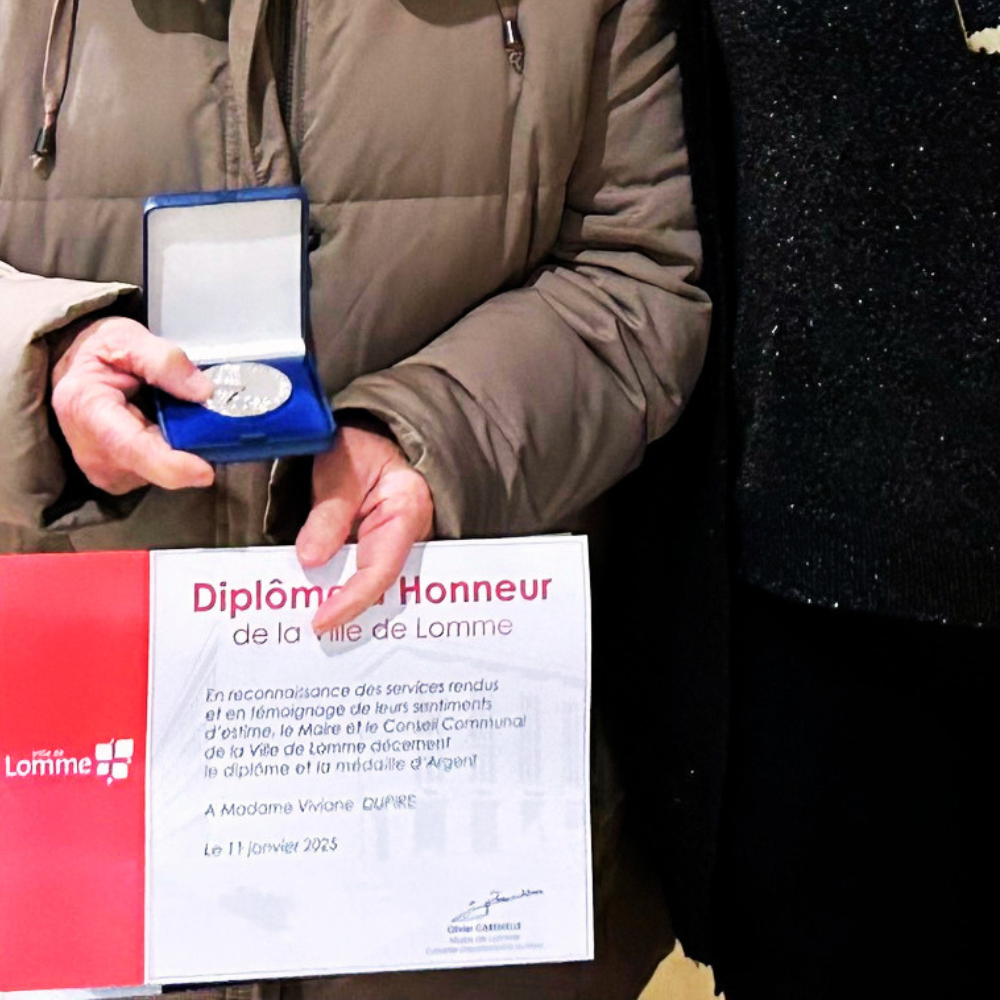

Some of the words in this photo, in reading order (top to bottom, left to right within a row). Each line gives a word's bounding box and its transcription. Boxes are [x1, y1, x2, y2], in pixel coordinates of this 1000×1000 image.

[233, 624, 268, 645] de
[278, 622, 300, 644] la
[372, 619, 407, 639] de
[416, 617, 513, 639] Lomme
[205, 689, 224, 702] En
[355, 683, 382, 696] des
[386, 680, 444, 695] services
[449, 678, 499, 693] rendus
[205, 707, 221, 721] et
[225, 708, 246, 721] en
[350, 702, 370, 715] de
[442, 715, 527, 731] Communal
[204, 746, 225, 760] de
[284, 742, 304, 756] de
[5, 754, 92, 778] Lomme
[204, 803, 215, 817] A
[220, 801, 293, 817] Madame
[204, 842, 223, 857] Le
[303, 836, 338, 852] 2025
